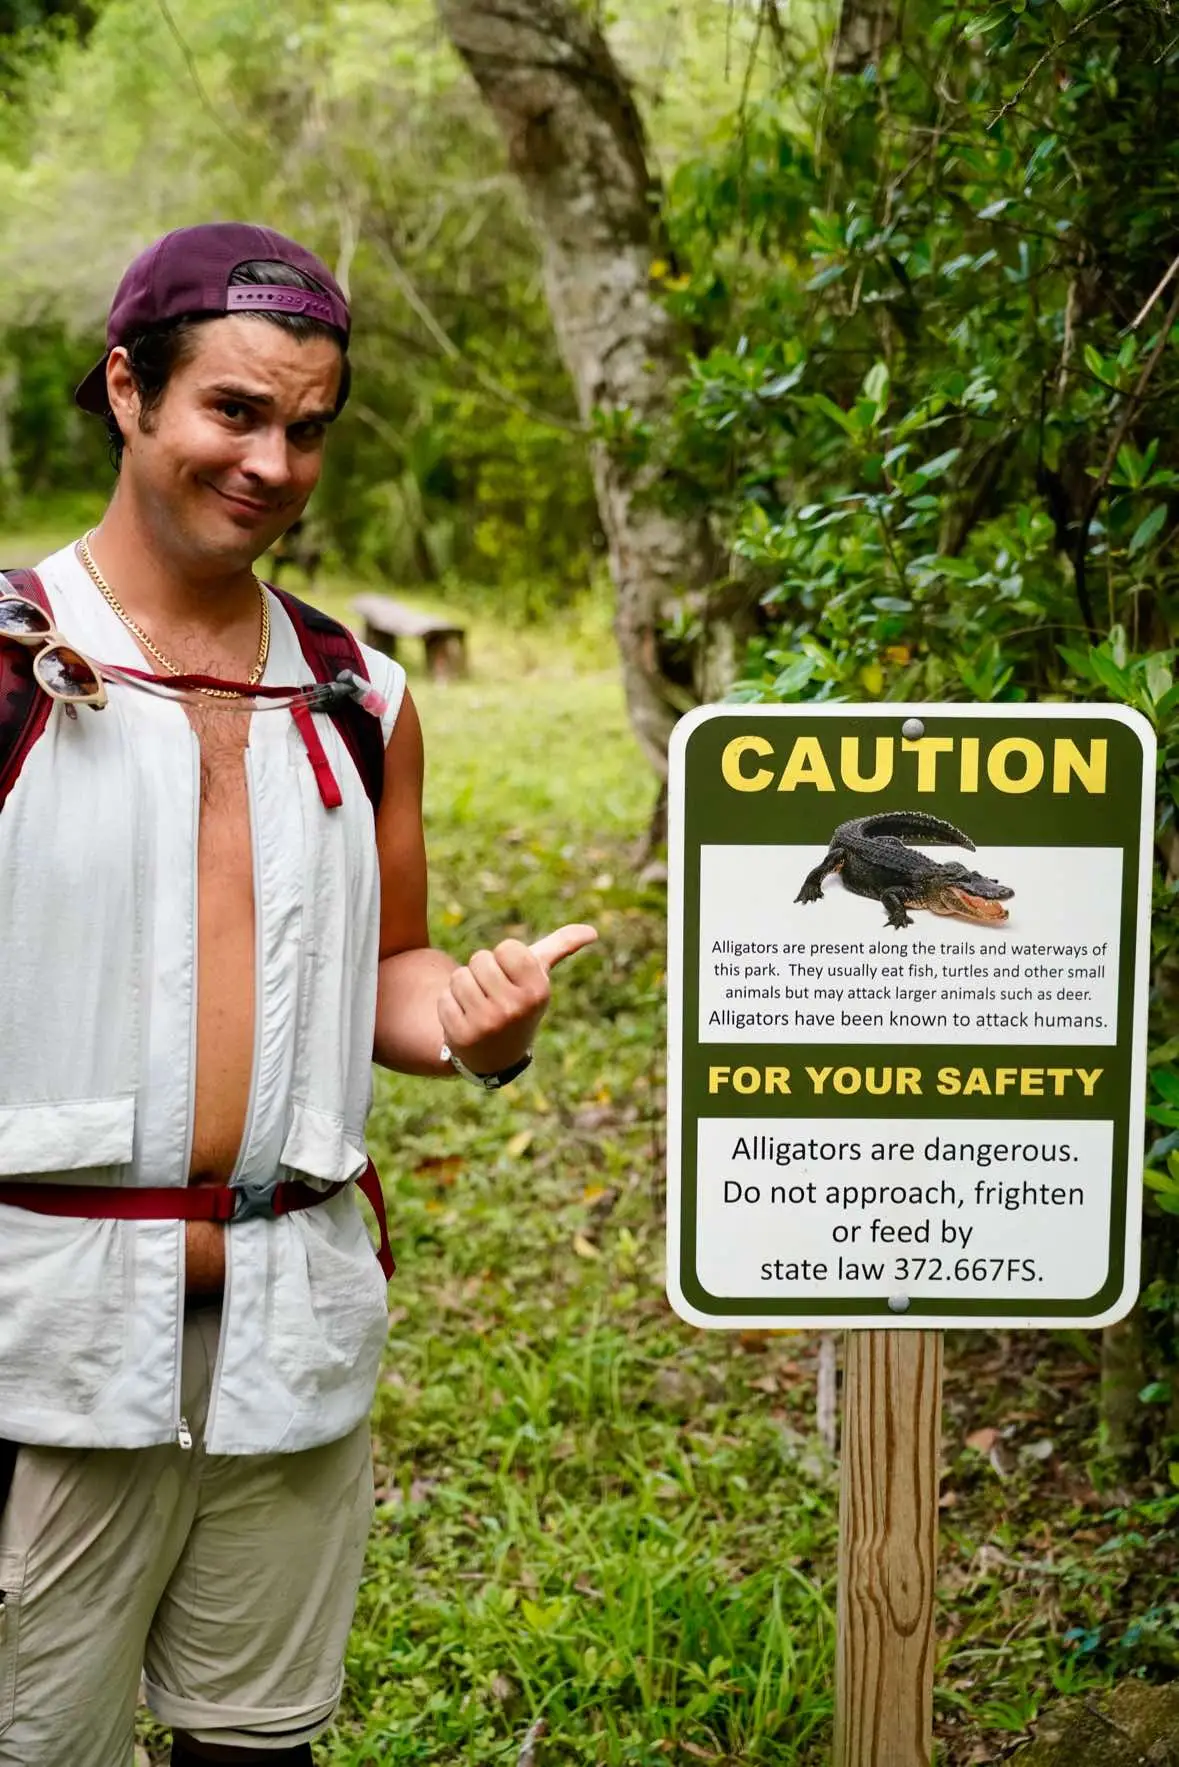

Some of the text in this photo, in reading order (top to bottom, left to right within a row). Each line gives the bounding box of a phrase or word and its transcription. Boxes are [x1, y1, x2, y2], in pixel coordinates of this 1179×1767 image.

[721, 735, 1108, 794] CAUTION
[711, 939, 1108, 959] Alligators are present along the trails and waterways of
[713, 962, 1105, 980] this park. They usually eat fish, turtles and other small
[725, 985, 1092, 1003] animals but may attack larger animals such as deer.
[708, 1009, 1108, 1030] Alligators have been known to attack humans.
[708, 1066, 1104, 1096] FOR YOUR SAFETY
[731, 1135, 1079, 1168] Alligators are dangerous.
[724, 1179, 1084, 1211] Do not approach, frighten
[832, 1218, 974, 1250] or feed by
[760, 1255, 1043, 1282] state law 372.667FS.
